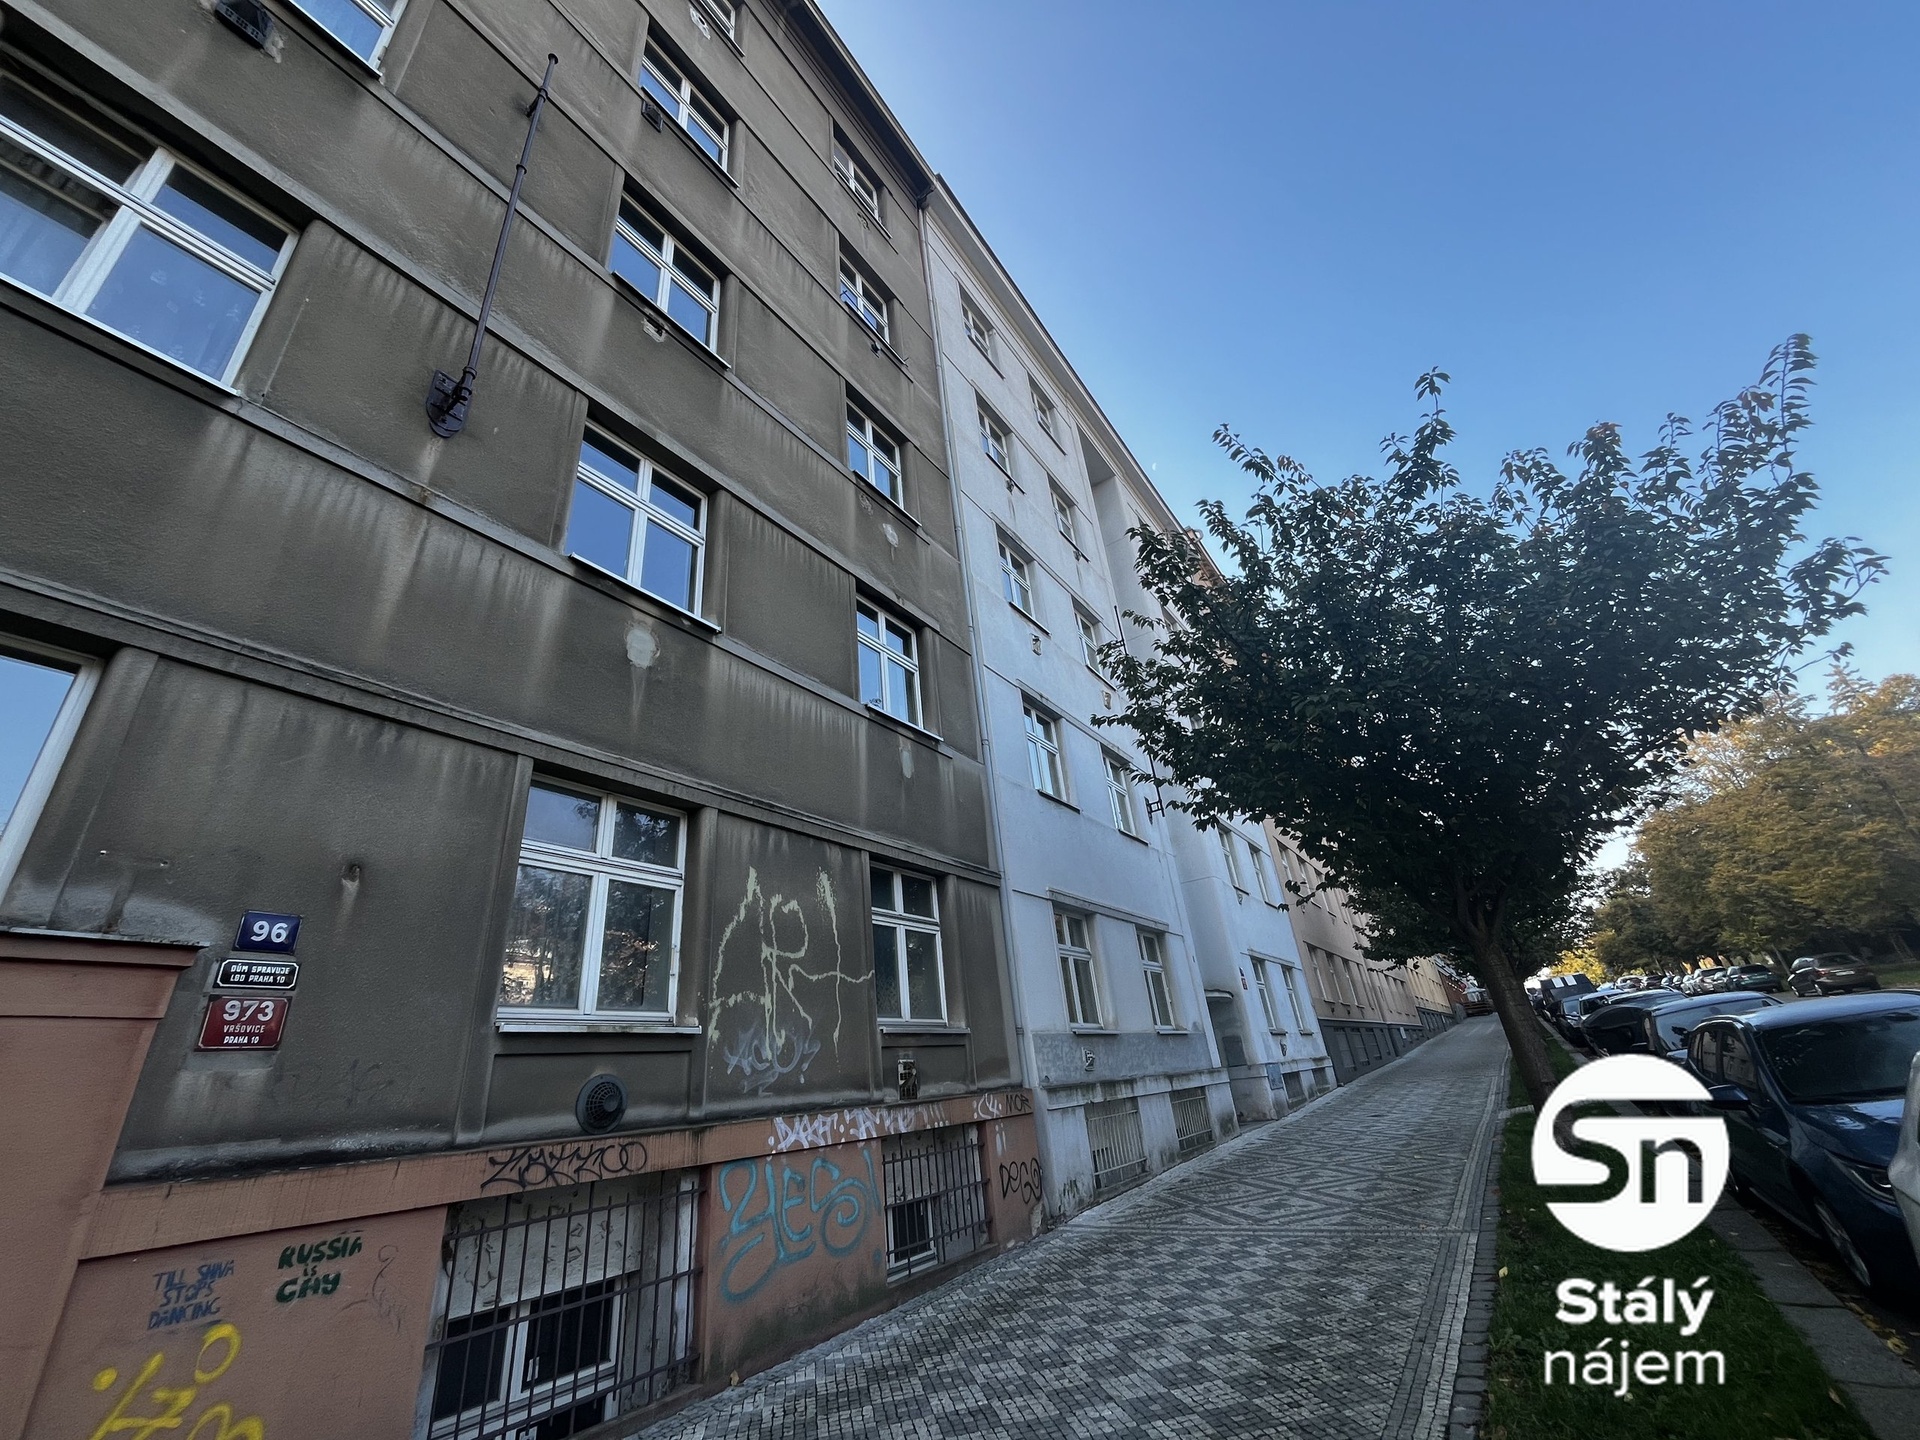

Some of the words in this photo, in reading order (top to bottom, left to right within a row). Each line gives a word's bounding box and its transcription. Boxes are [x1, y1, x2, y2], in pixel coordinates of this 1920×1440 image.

[250, 920, 289, 943] 96
[251, 965, 290, 975] SPRAVUJE
[248, 975, 274, 983] PRAHA
[276, 976, 286, 984] 10
[222, 1000, 275, 1022] 973
[223, 1023, 266, 1034] VRŠOVICE
[223, 1035, 249, 1044] PRAHA
[250, 1035, 260, 1044] 10
[277, 1236, 363, 1270] RUSSIA
